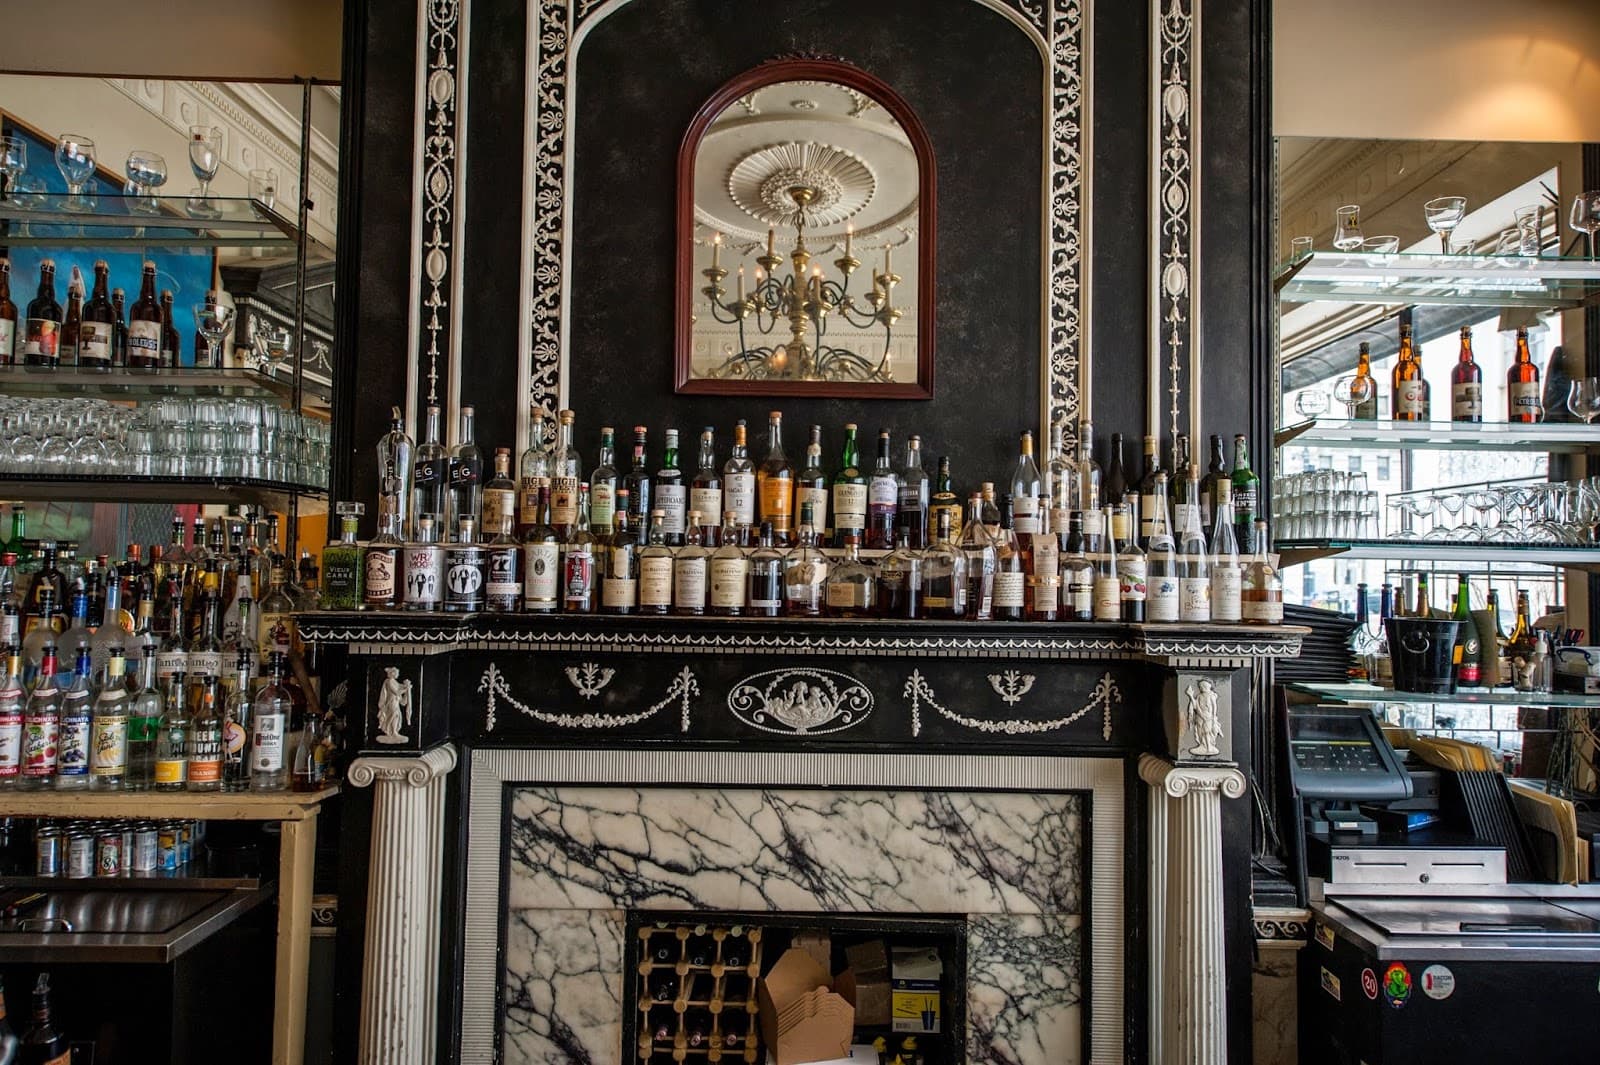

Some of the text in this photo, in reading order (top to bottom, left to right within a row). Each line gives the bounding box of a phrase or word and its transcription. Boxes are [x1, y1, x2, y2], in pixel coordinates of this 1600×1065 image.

[521, 477, 541, 485] HIG
[551, 477, 576, 485] HIGH
[736, 499, 743, 507] 12
[491, 555, 511, 571] 77
[224, 659, 255, 668] Tano
[1364, 975, 1377, 993] 20
